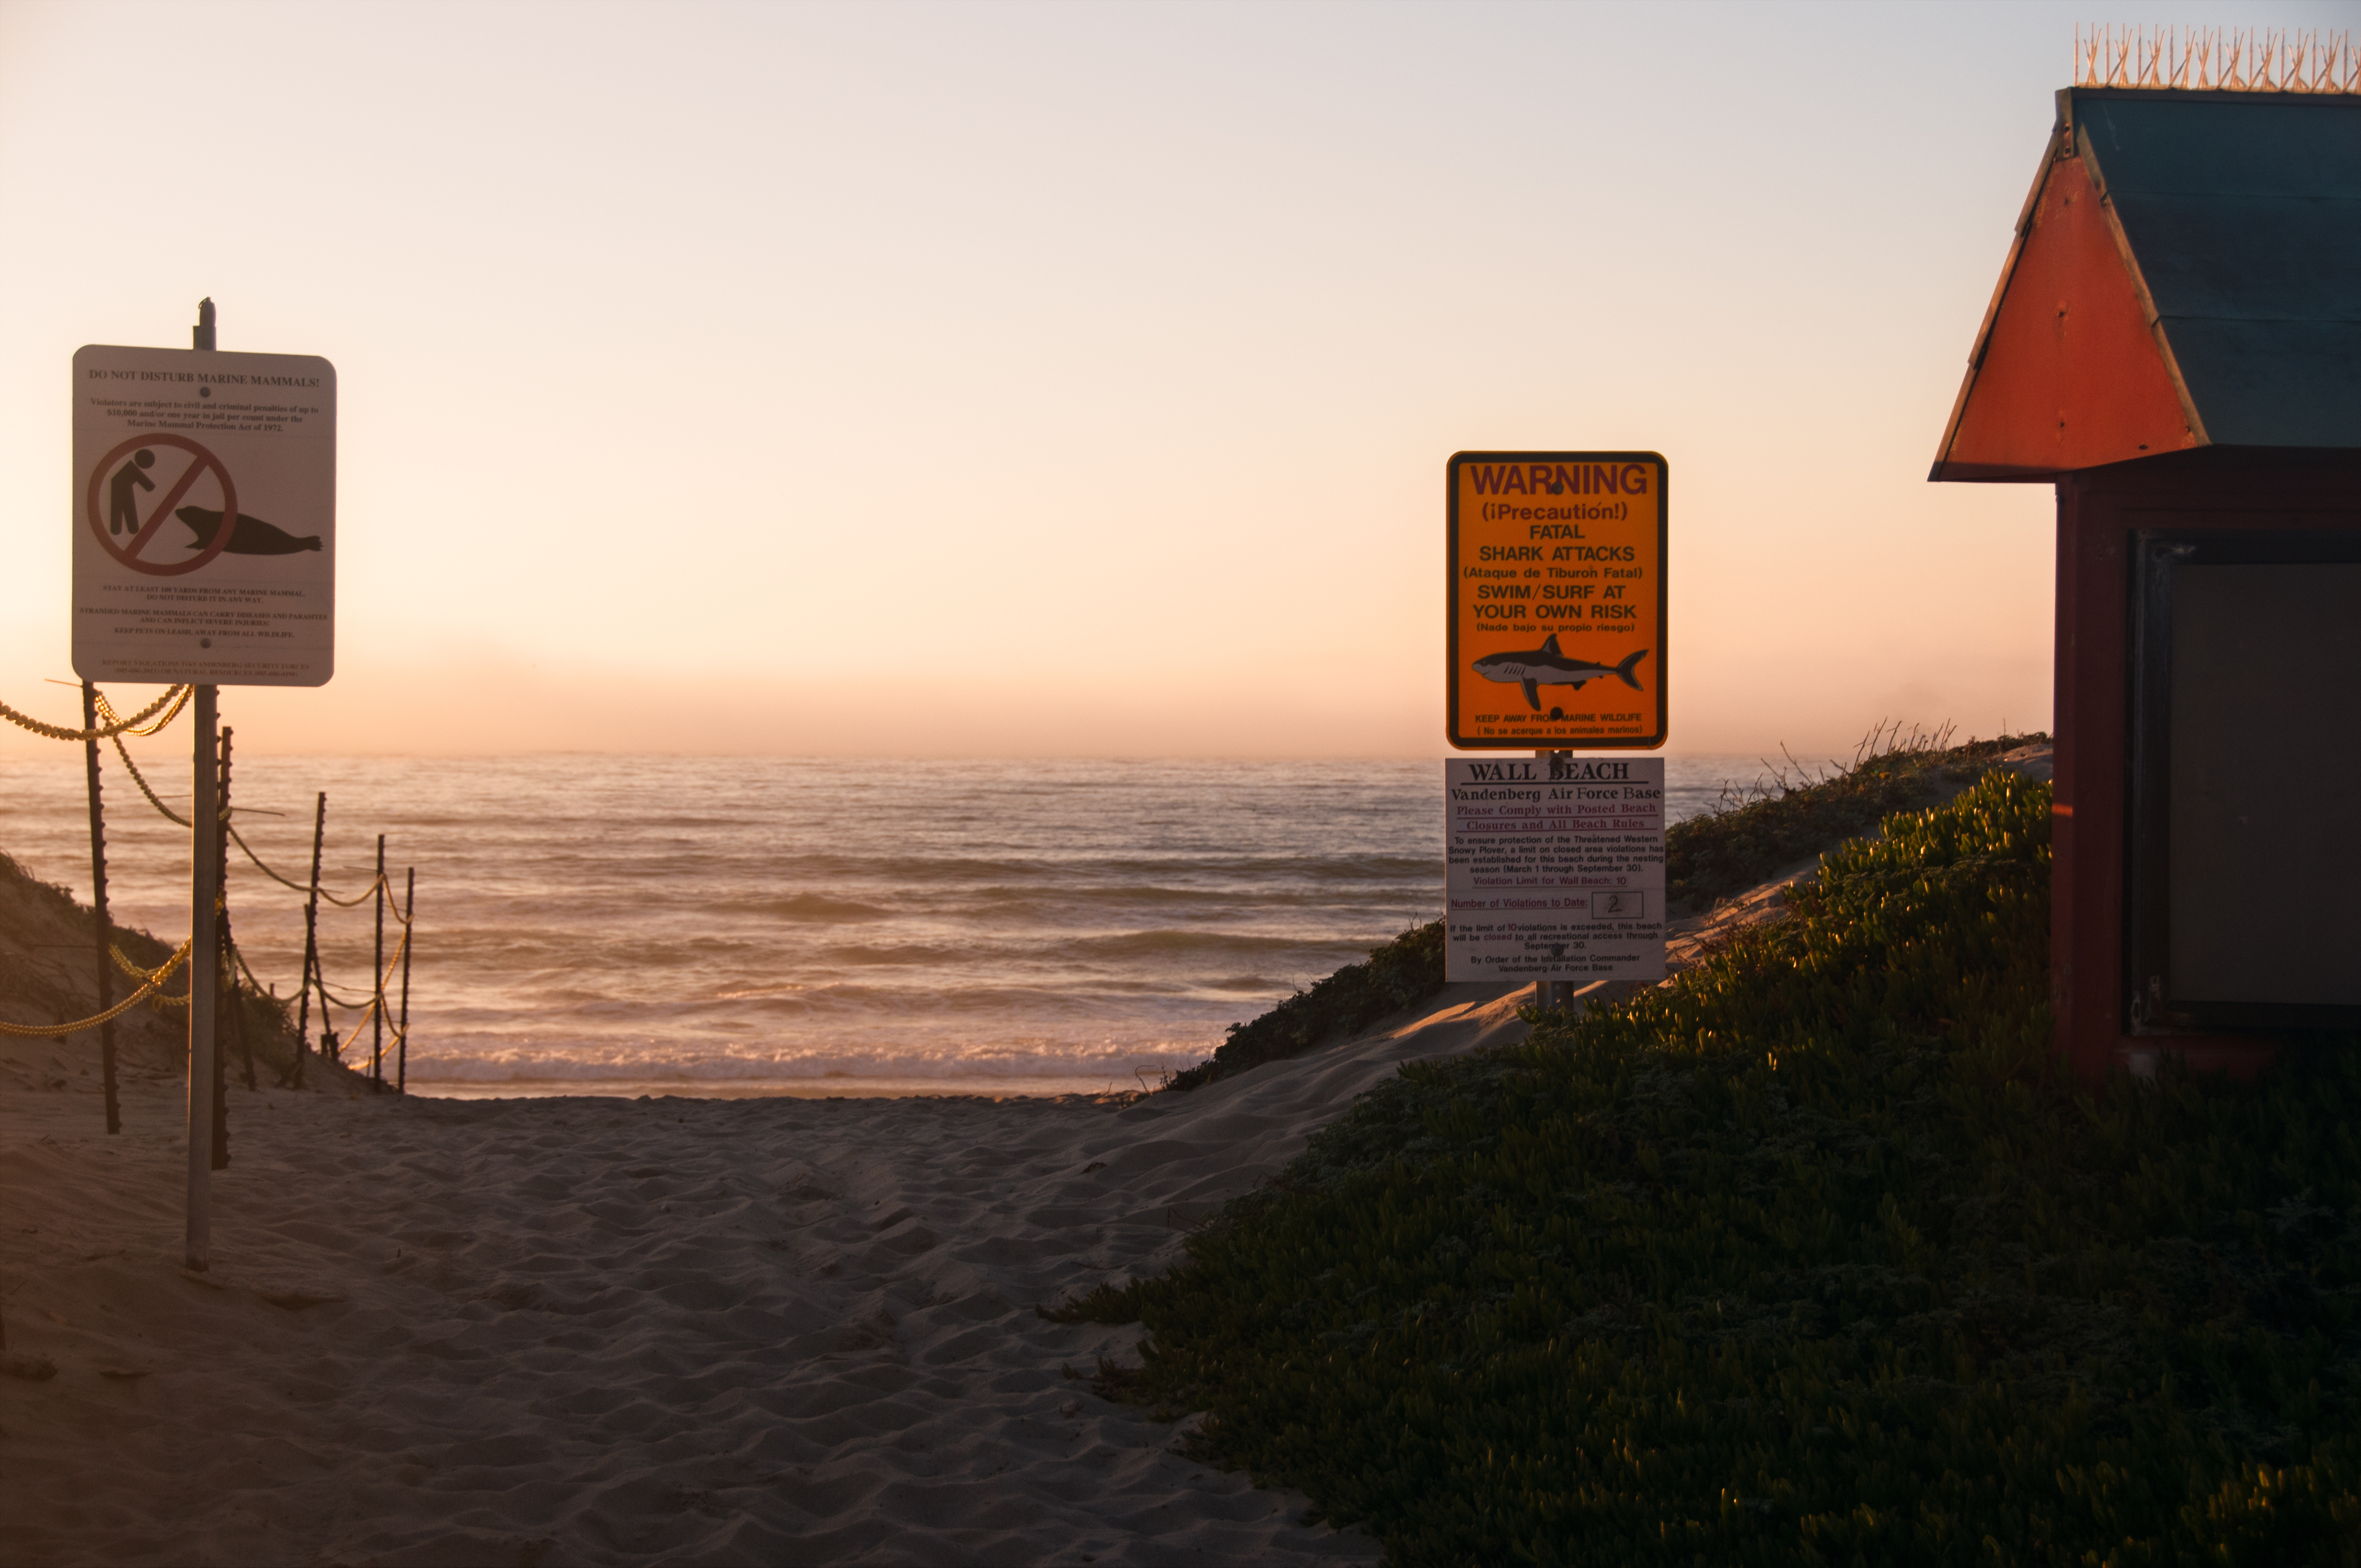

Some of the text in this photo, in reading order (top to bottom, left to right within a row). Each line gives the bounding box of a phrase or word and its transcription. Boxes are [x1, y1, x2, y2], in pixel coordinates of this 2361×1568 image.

[89, 370, 319, 387] DO NOT DISTURB MARINE MAMMALS!
[90, 399, 127, 407] Violators
[144, 401, 171, 410] subject
[219, 403, 251, 411] criminal
[254, 405, 287, 413] penalties
[107, 409, 137, 418] $10,000
[213, 413, 225, 421] jail
[128, 420, 156, 428] Marine
[159, 421, 194, 429] Mammal
[196, 422, 236, 430] Protection
[1470, 465, 1647, 494] WARNING
[1530, 525, 1585, 540] FATAL
[1480, 546, 1634, 561] SHARK ATTACKS
[1464, 567, 1516, 579] (Ataque
[1524, 567, 1539, 578] de
[1604, 567, 1642, 578] Fatal)
[1478, 584, 1626, 600] SWIM/SURF AT
[1473, 605, 1636, 619] YOUR OWN RISK
[1477, 623, 1508, 632] (Nade
[1513, 623, 1536, 632] bajo
[1558, 623, 1592, 632] propio
[1597, 623, 1634, 632] riesgo)
[1608, 725, 1642, 733] marinos)
[1468, 763, 1629, 781] WALL BEACH
[1451, 787, 1661, 803] Vandenberg Air Force Base
[1457, 803, 1656, 816] Please Comply with Posted Beach
[1467, 819, 1644, 830] Closures and All Beach Rules
[1499, 836, 1542, 845] protection
[1448, 846, 1476, 855] Snowy
[1479, 846, 1506, 854] Plover,
[1587, 855, 1613, 863] during
[1633, 854, 1663, 863] nesting
[1503, 864, 1532, 873] (March
[1543, 864, 1574, 873] through
[1577, 864, 1622, 873] September
[1626, 864, 1643, 872] 30).
[1451, 898, 1588, 907] Number of Violations to Date:
[1608, 895, 1623, 913] 2
[1626, 932, 1657, 940] through
[1471, 956, 1481, 965] By
